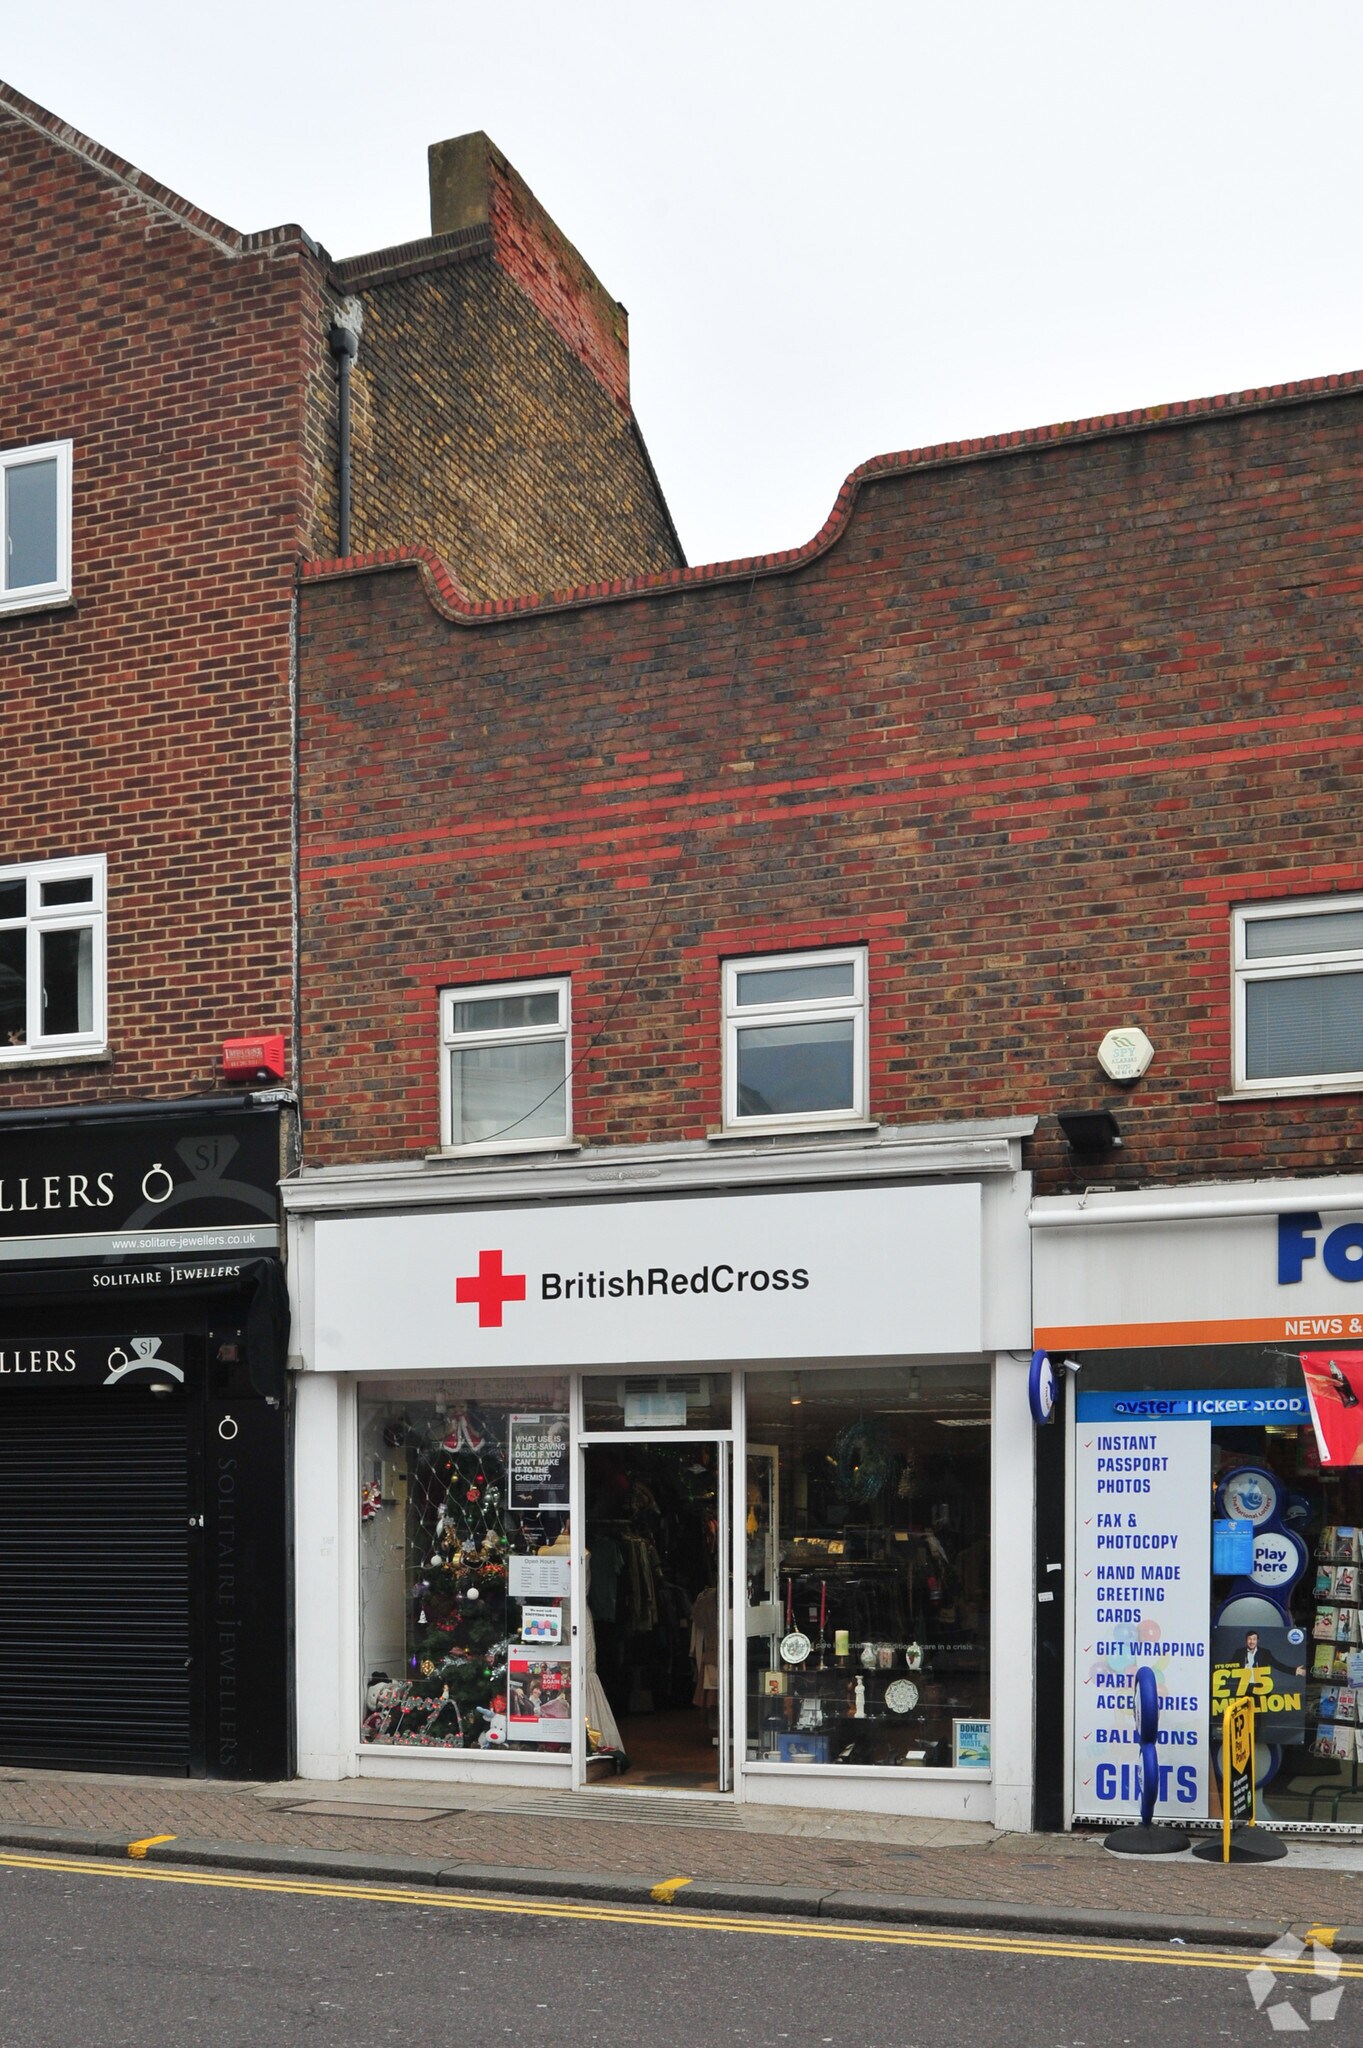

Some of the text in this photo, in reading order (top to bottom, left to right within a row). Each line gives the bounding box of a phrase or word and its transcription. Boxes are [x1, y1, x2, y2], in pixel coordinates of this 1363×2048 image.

[1113, 1047, 1136, 1058] SPY
[112, 1233, 256, 1249] www.solitare-jewellers.co.uk
[92, 1266, 240, 1287] SOLITAIRE JEWELLERS
[541, 1264, 810, 1300] BritishRedCross
[1285, 1318, 1363, 1336] NEWS &
[1098, 1436, 1157, 1450] INSTANT
[1098, 1457, 1168, 1472] PASSPORT
[1098, 1478, 1151, 1494] PHOTOS
[1235, 1506, 1258, 1518] National
[1258, 1497, 1272, 1516] Lottery
[1097, 1513, 1138, 1528] FAX &
[1097, 1534, 1178, 1549] PHOTOCOPY
[1256, 1548, 1287, 1562] Play
[1097, 1566, 1181, 1580] HAND MADE
[1254, 1560, 1288, 1572] here
[1097, 1588, 1165, 1602] GREETING
[1097, 1608, 1141, 1623] CARDS
[1096, 1642, 1205, 1657] GIFT WRAPPING
[1096, 1674, 1134, 1688] PART
[1212, 1666, 1274, 1698] £75
[1096, 1695, 1198, 1711] ACCEORIES
[1212, 1692, 1301, 1716] MILION
[1096, 1728, 1198, 1746] BALLONS
